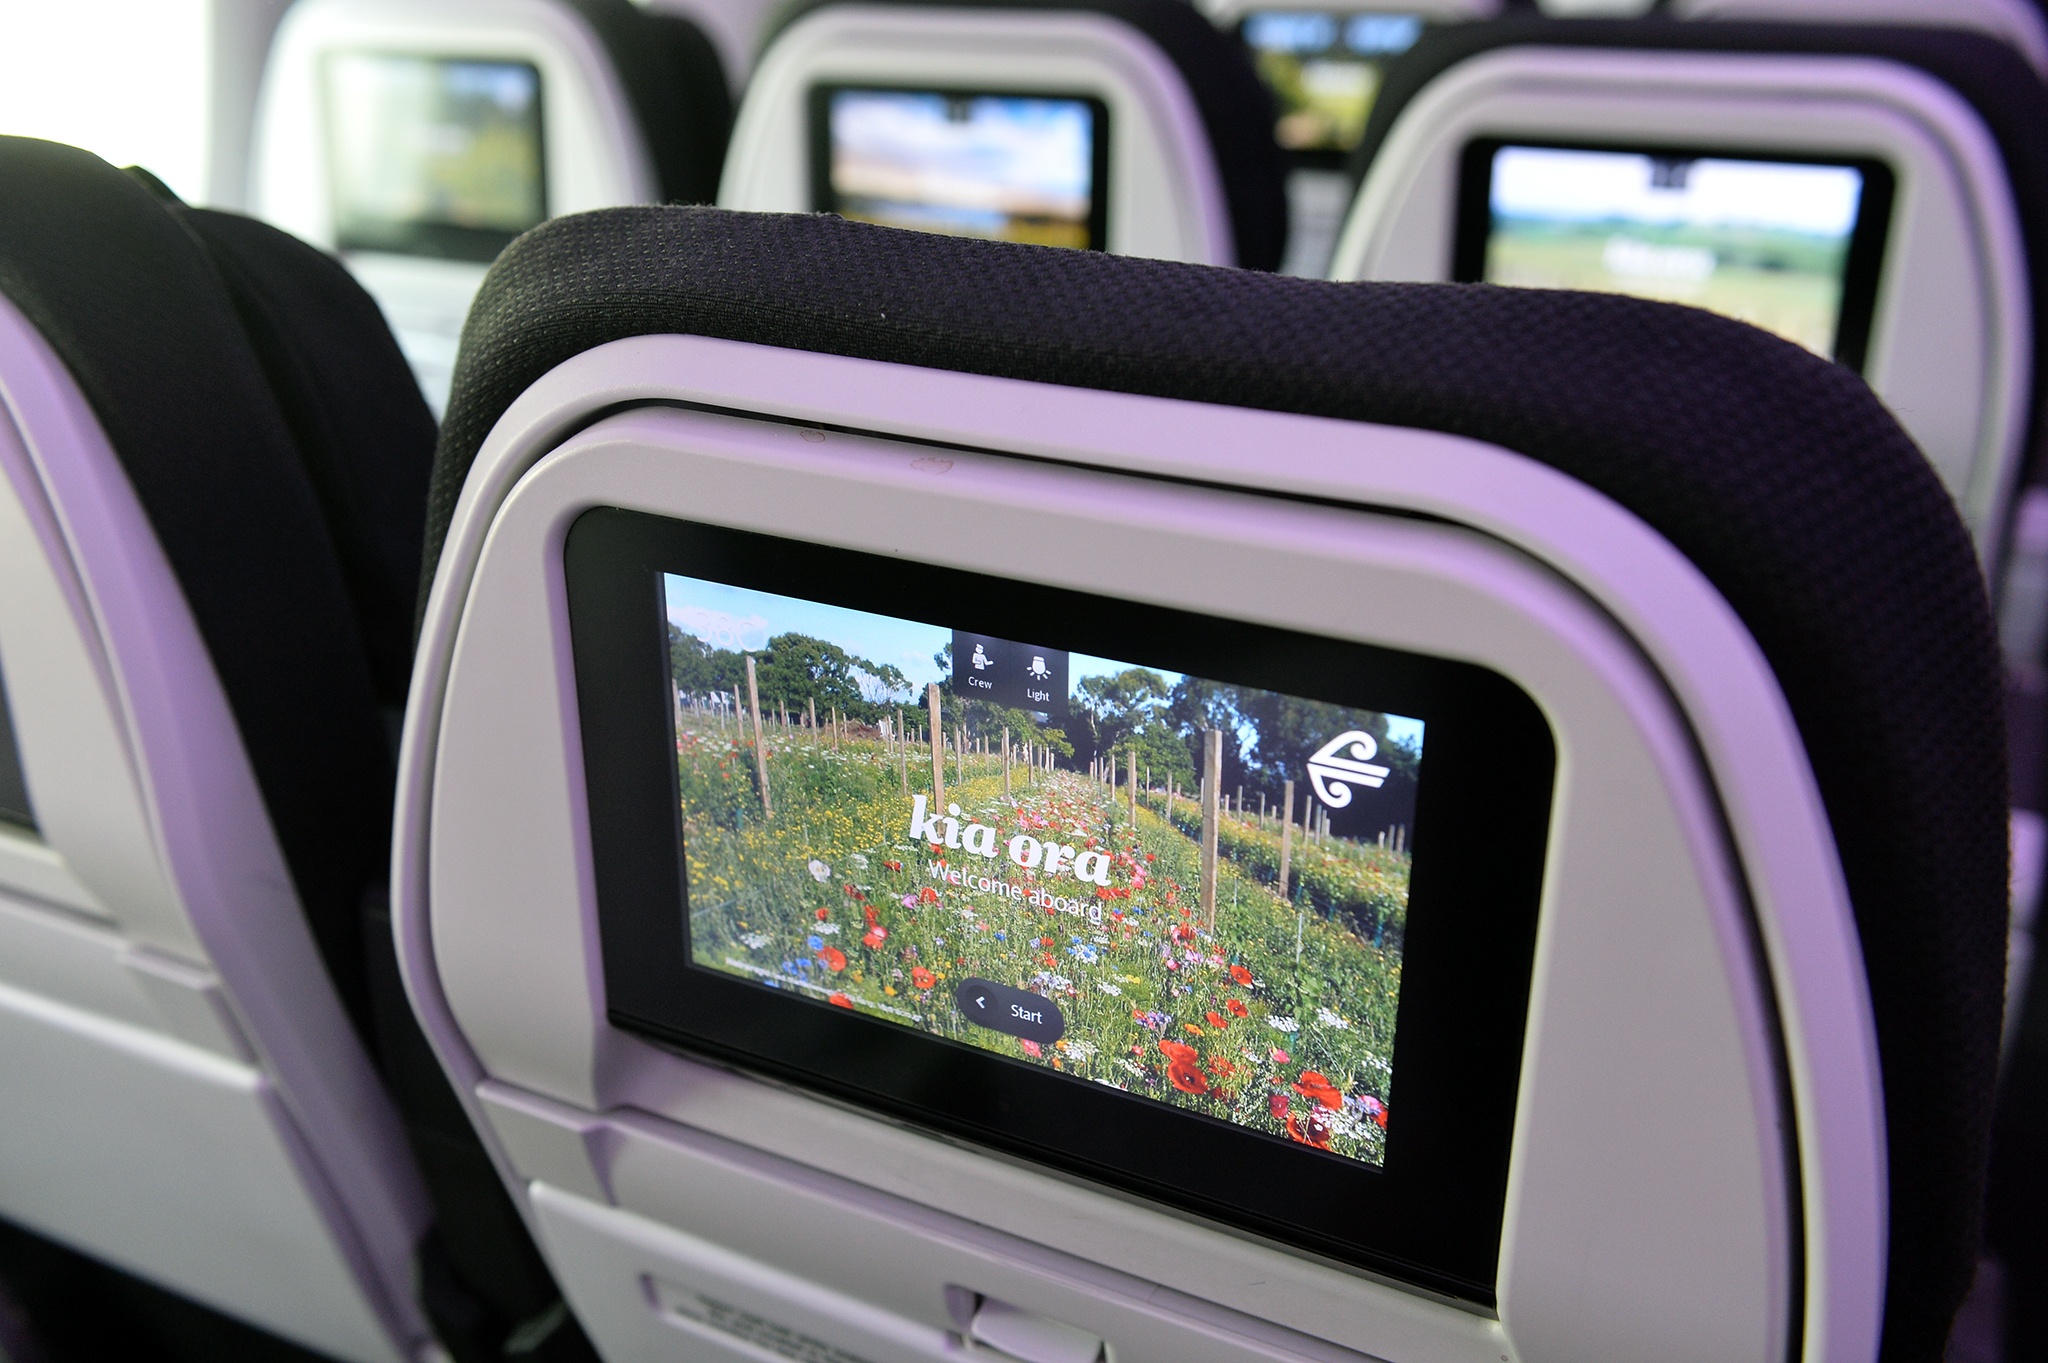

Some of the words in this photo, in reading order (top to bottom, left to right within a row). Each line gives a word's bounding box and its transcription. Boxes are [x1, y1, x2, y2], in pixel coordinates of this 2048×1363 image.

[968, 676, 993, 690] Crew
[1027, 688, 1050, 702] Light
[909, 794, 999, 859] kia
[1008, 835, 1112, 887] ora
[928, 859, 1023, 901] Welcome
[1028, 887, 1103, 921] aboard
[1010, 1004, 1043, 1025] Start
